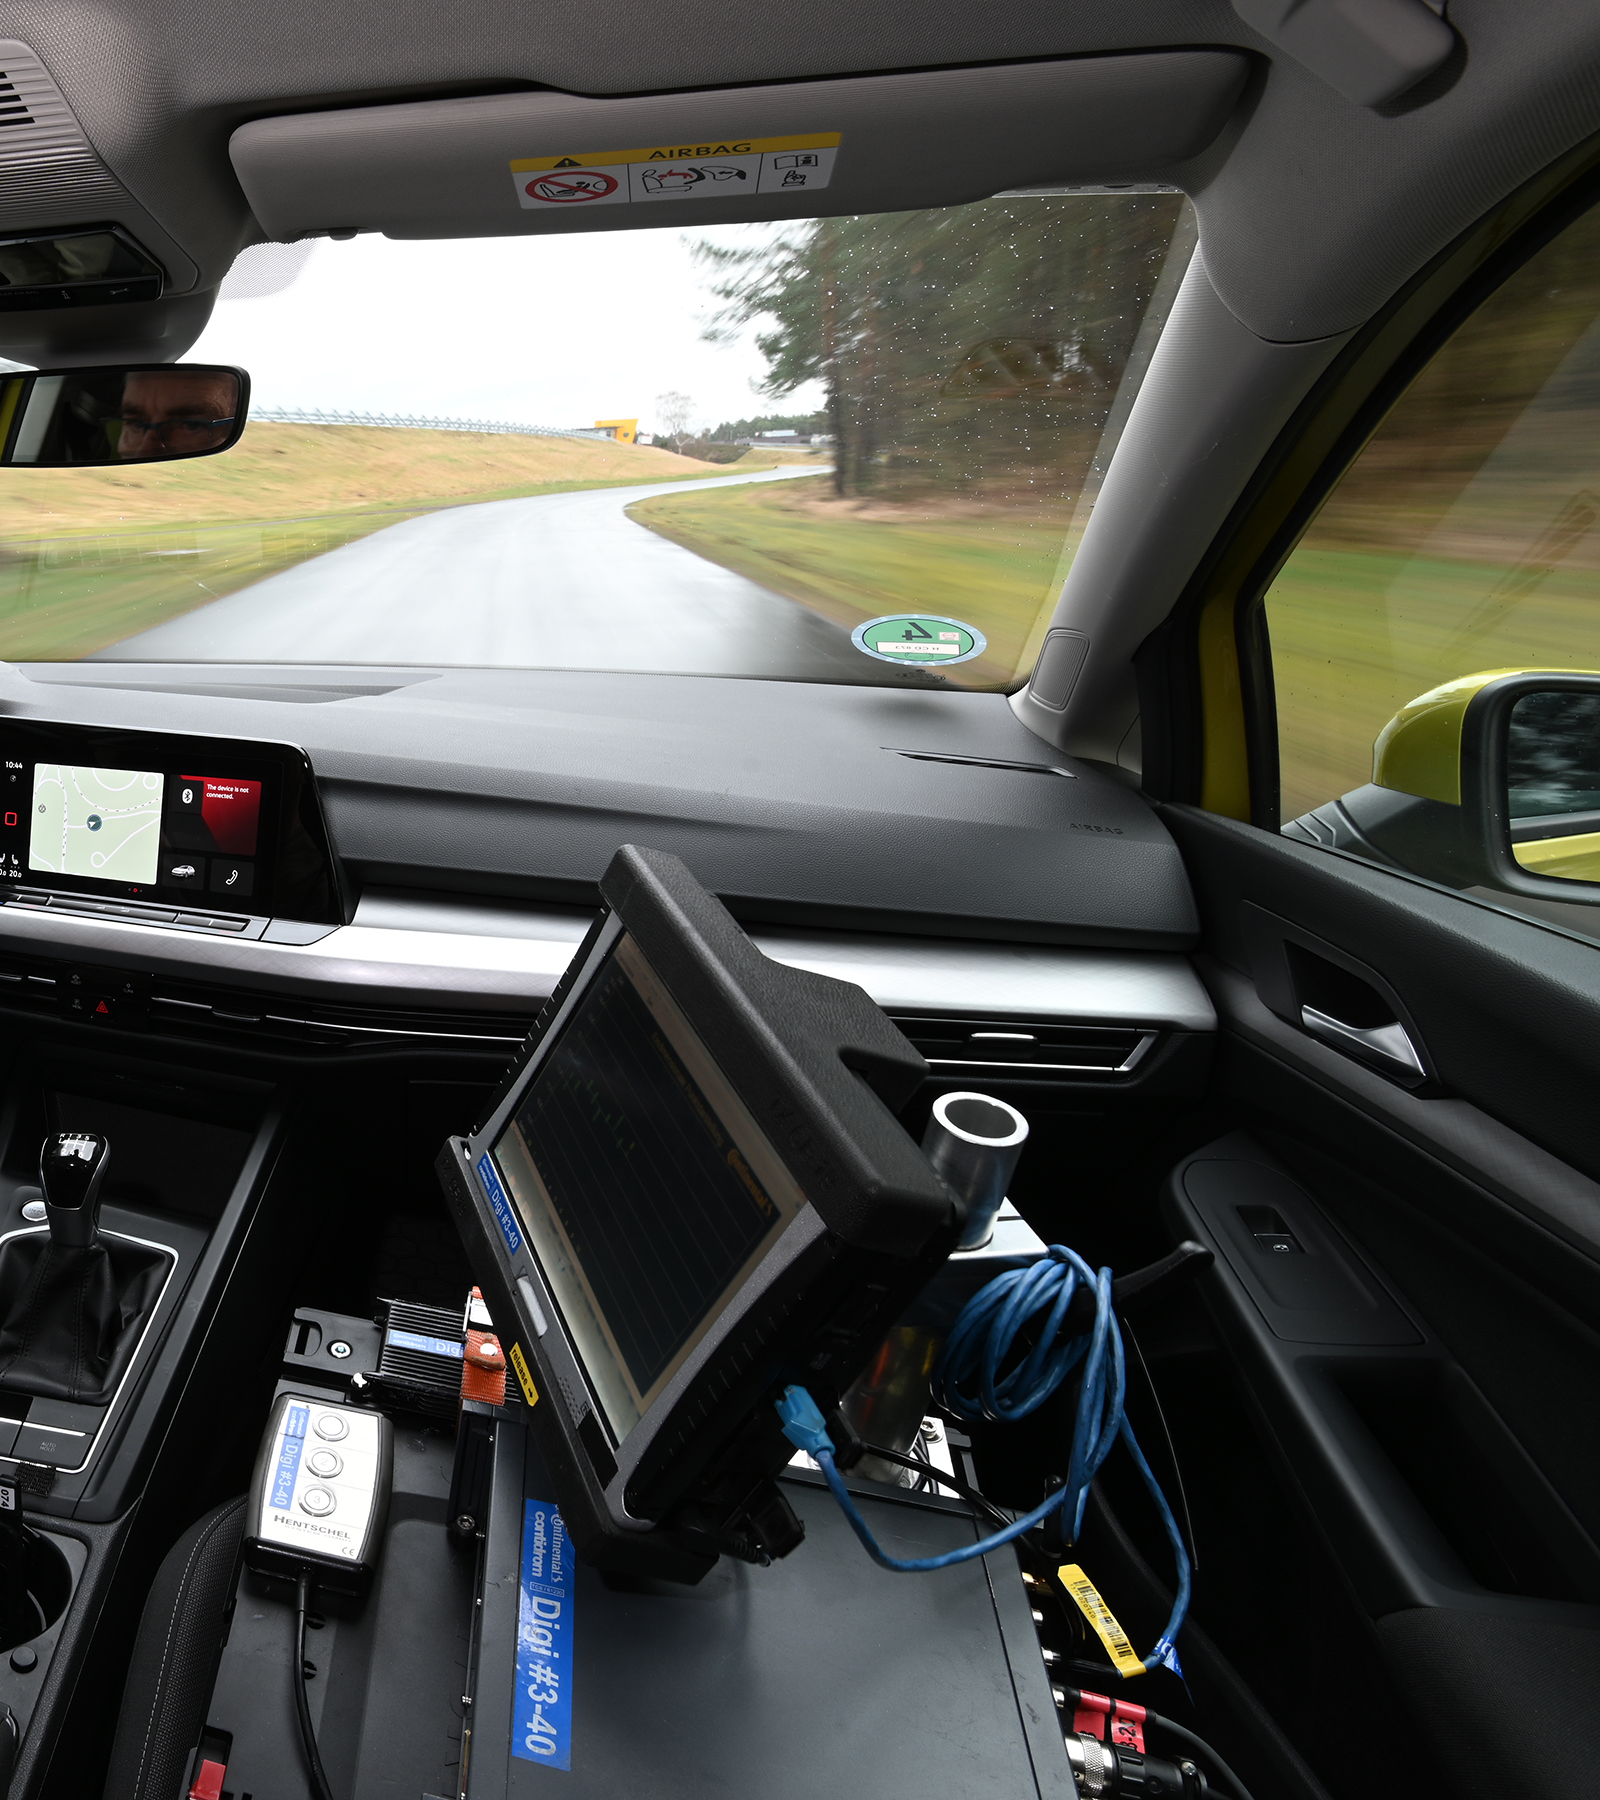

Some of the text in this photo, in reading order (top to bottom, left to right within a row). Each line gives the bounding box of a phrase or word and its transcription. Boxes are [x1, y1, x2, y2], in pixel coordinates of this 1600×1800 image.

[649, 143, 751, 160] AIRBAG
[5, 761, 23, 770] 10:44
[206, 792, 234, 800] connected.
[1070, 823, 1124, 835] AIRBAG
[8, 870, 22, 878] 20.0
[491, 1188, 519, 1249] Digi #3-40
[436, 1342, 464, 1357] Digi
[511, 1348, 529, 1386] release
[320, 1458, 329, 1467] 2
[274, 1444, 299, 1506] Digi #3-40
[0, 1488, 10, 1508] 074
[313, 1495, 321, 1504] 3
[274, 1514, 351, 1540] HENTSCHEL
[342, 1546, 355, 1557] CE
[532, 1511, 547, 1578] contidrom
[550, 1513, 564, 1575] Continental
[523, 1595, 561, 1756] Digi #3-40
